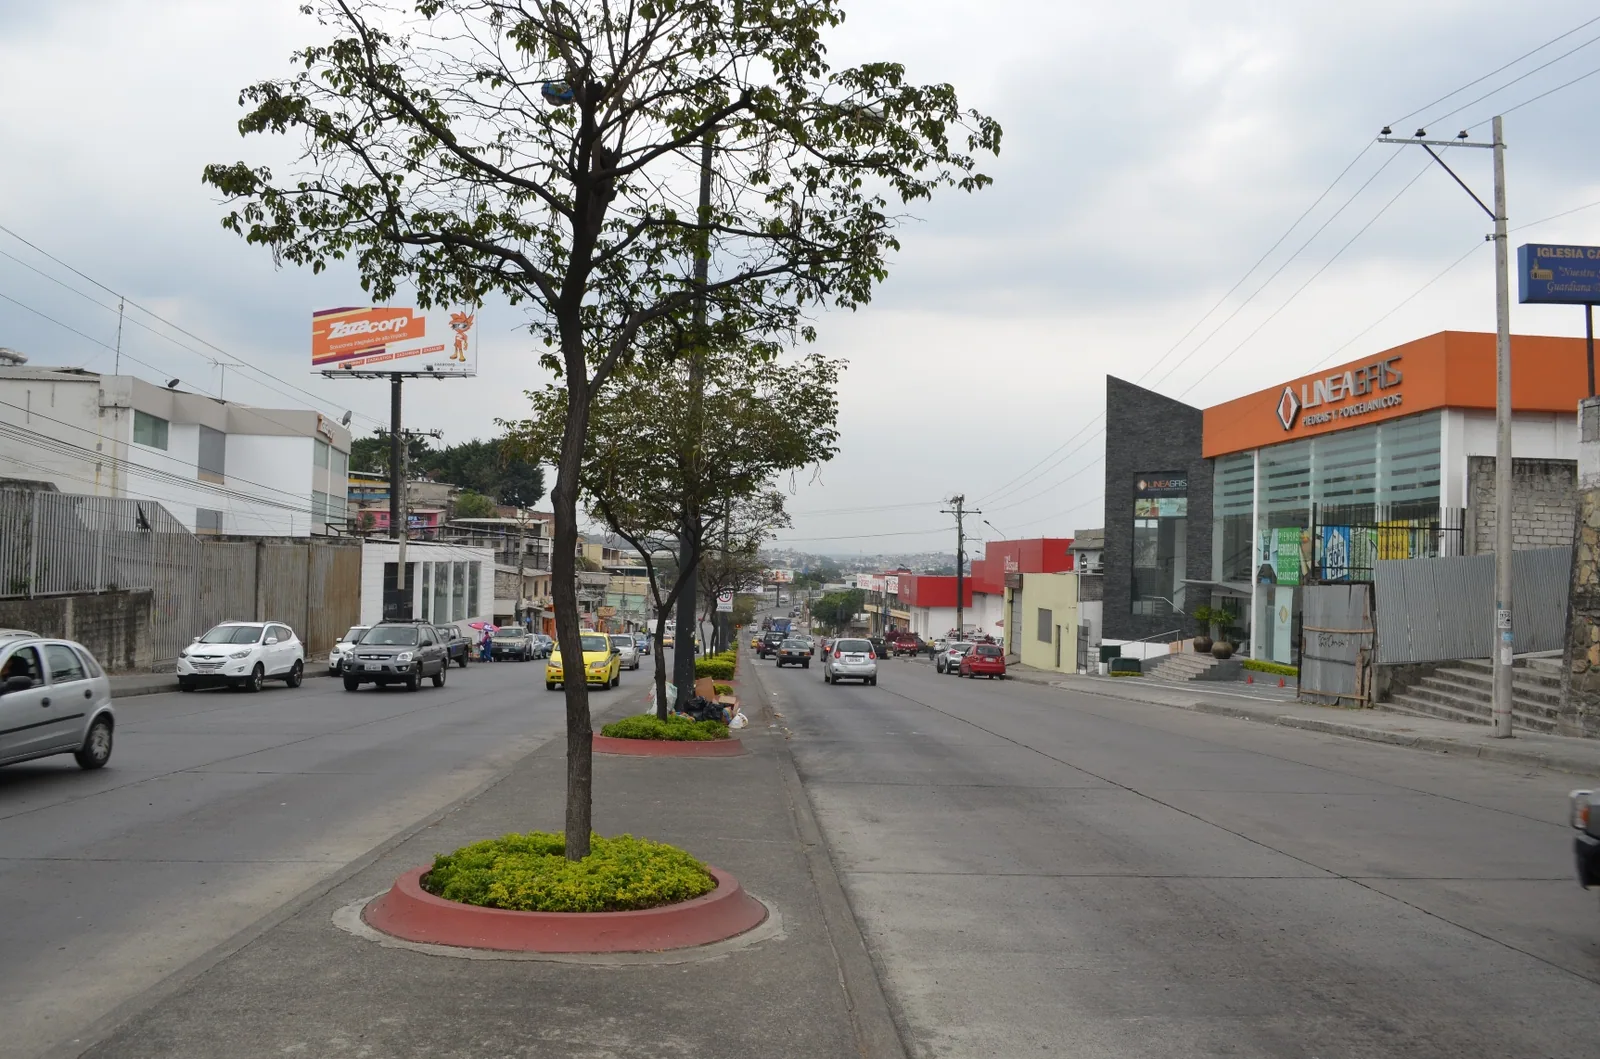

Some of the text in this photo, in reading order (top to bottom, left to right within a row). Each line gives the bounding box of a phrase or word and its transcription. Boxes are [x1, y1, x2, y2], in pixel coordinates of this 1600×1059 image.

[1537, 247, 1584, 259] IGLESIA
[326, 316, 408, 340] Zazacorp
[1302, 411, 1332, 427] PIEDRAS
[1278, 532, 1300, 541] PIENSAS
[1278, 557, 1299, 569] BUSCAS
